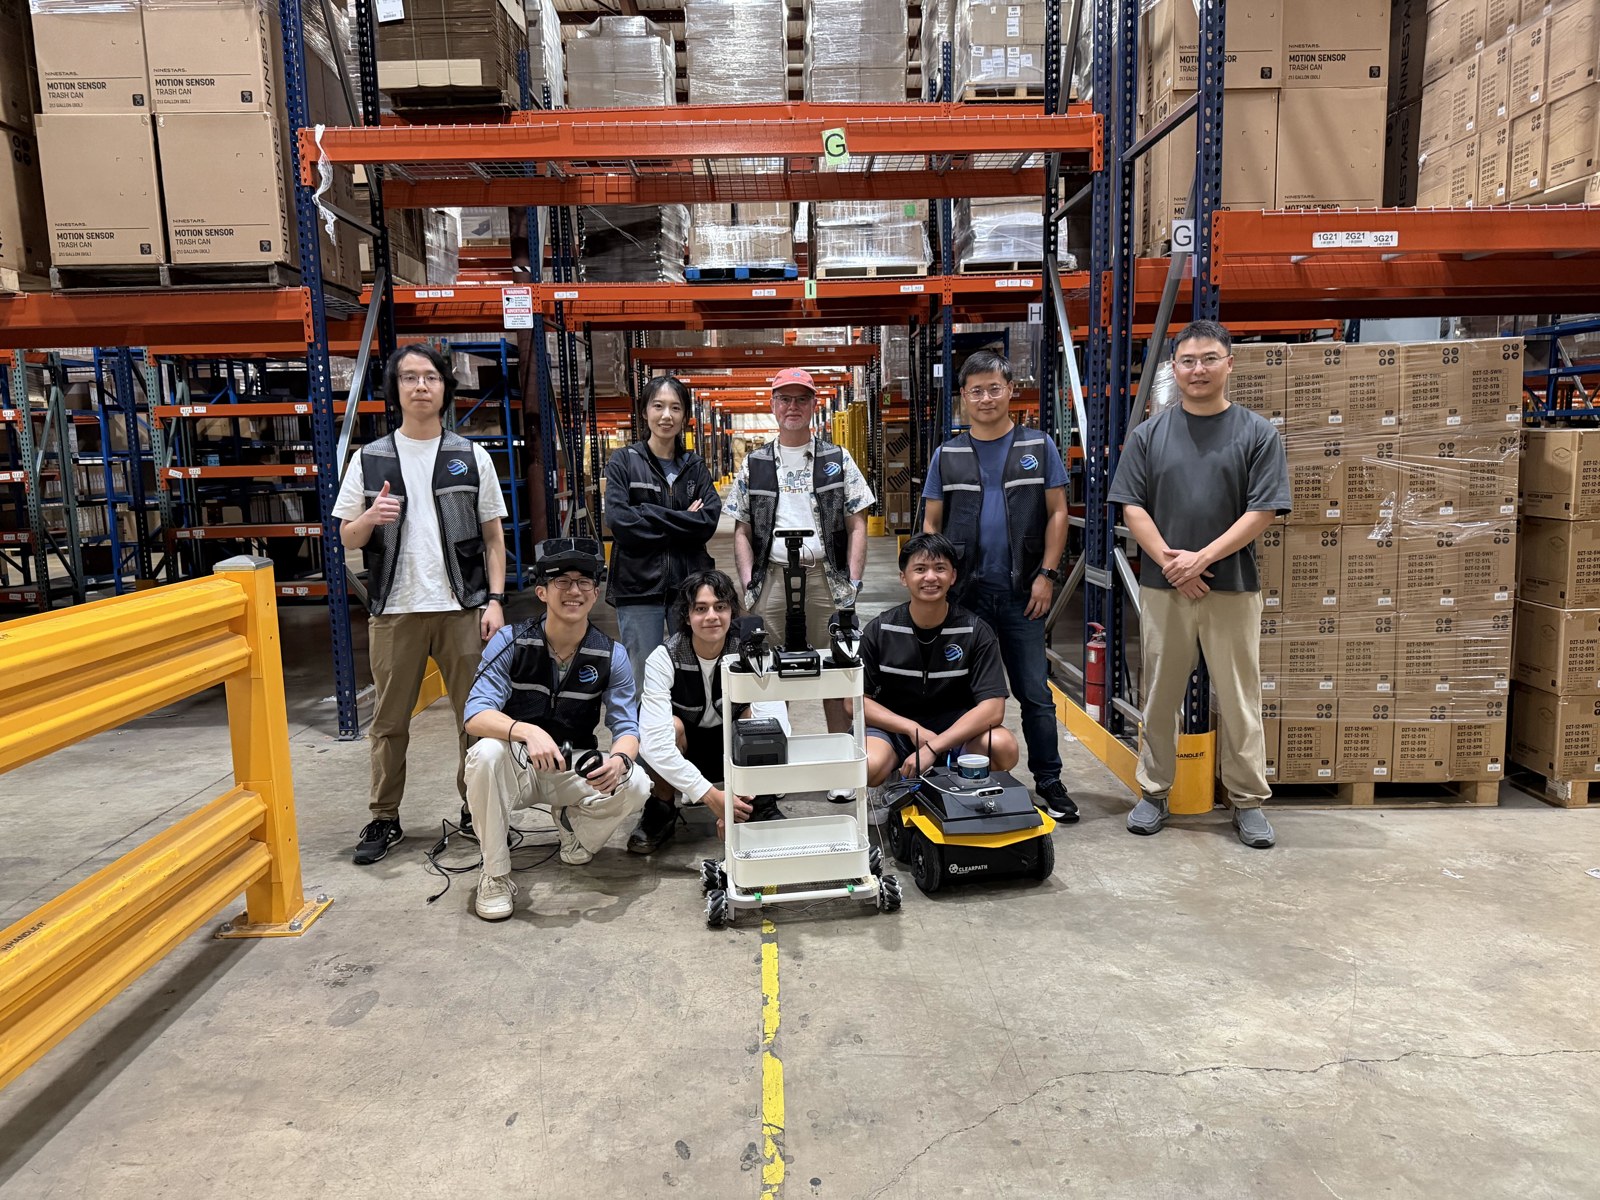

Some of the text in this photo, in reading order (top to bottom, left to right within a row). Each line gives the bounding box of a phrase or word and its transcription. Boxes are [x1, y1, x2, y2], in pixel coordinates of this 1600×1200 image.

[47, 82, 106, 90] MOTION SENSOR
[825, 133, 846, 157] G
[1174, 225, 1192, 246] G
[1030, 306, 1041, 321] H
[884, 394, 890, 403] K
